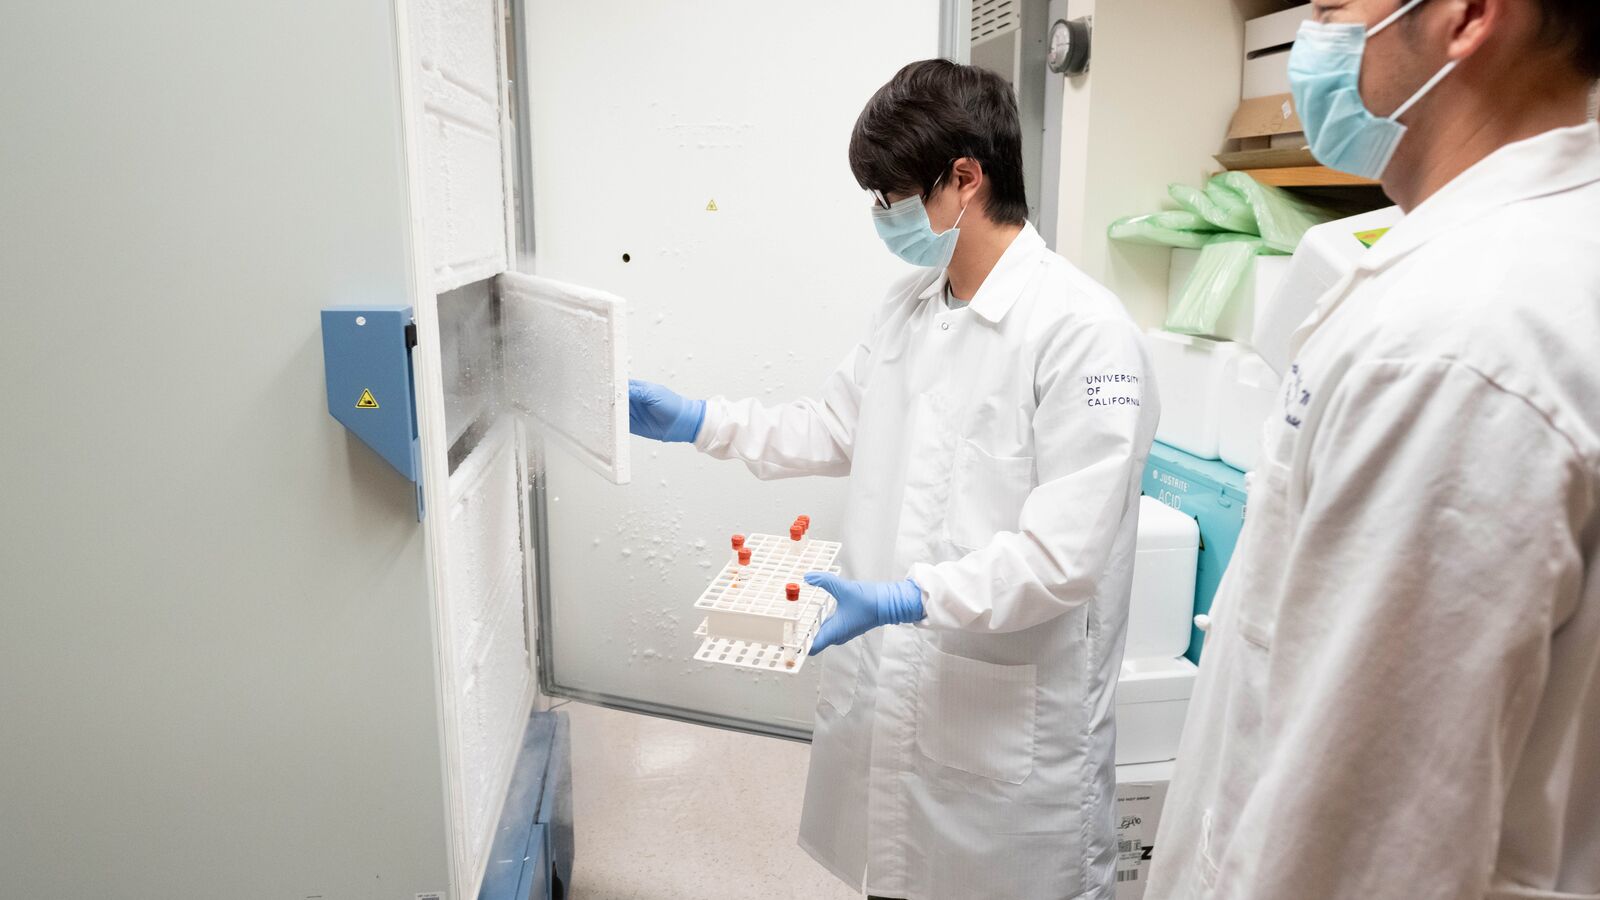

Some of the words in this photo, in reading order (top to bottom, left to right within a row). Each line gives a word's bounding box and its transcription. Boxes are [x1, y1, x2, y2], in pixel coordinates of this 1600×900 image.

[1086, 374, 1139, 384] UNIVERSITY
[1086, 386, 1101, 396] OF
[1159, 474, 1188, 492] JUSTRITE
[1159, 489, 1181, 509] ACID
